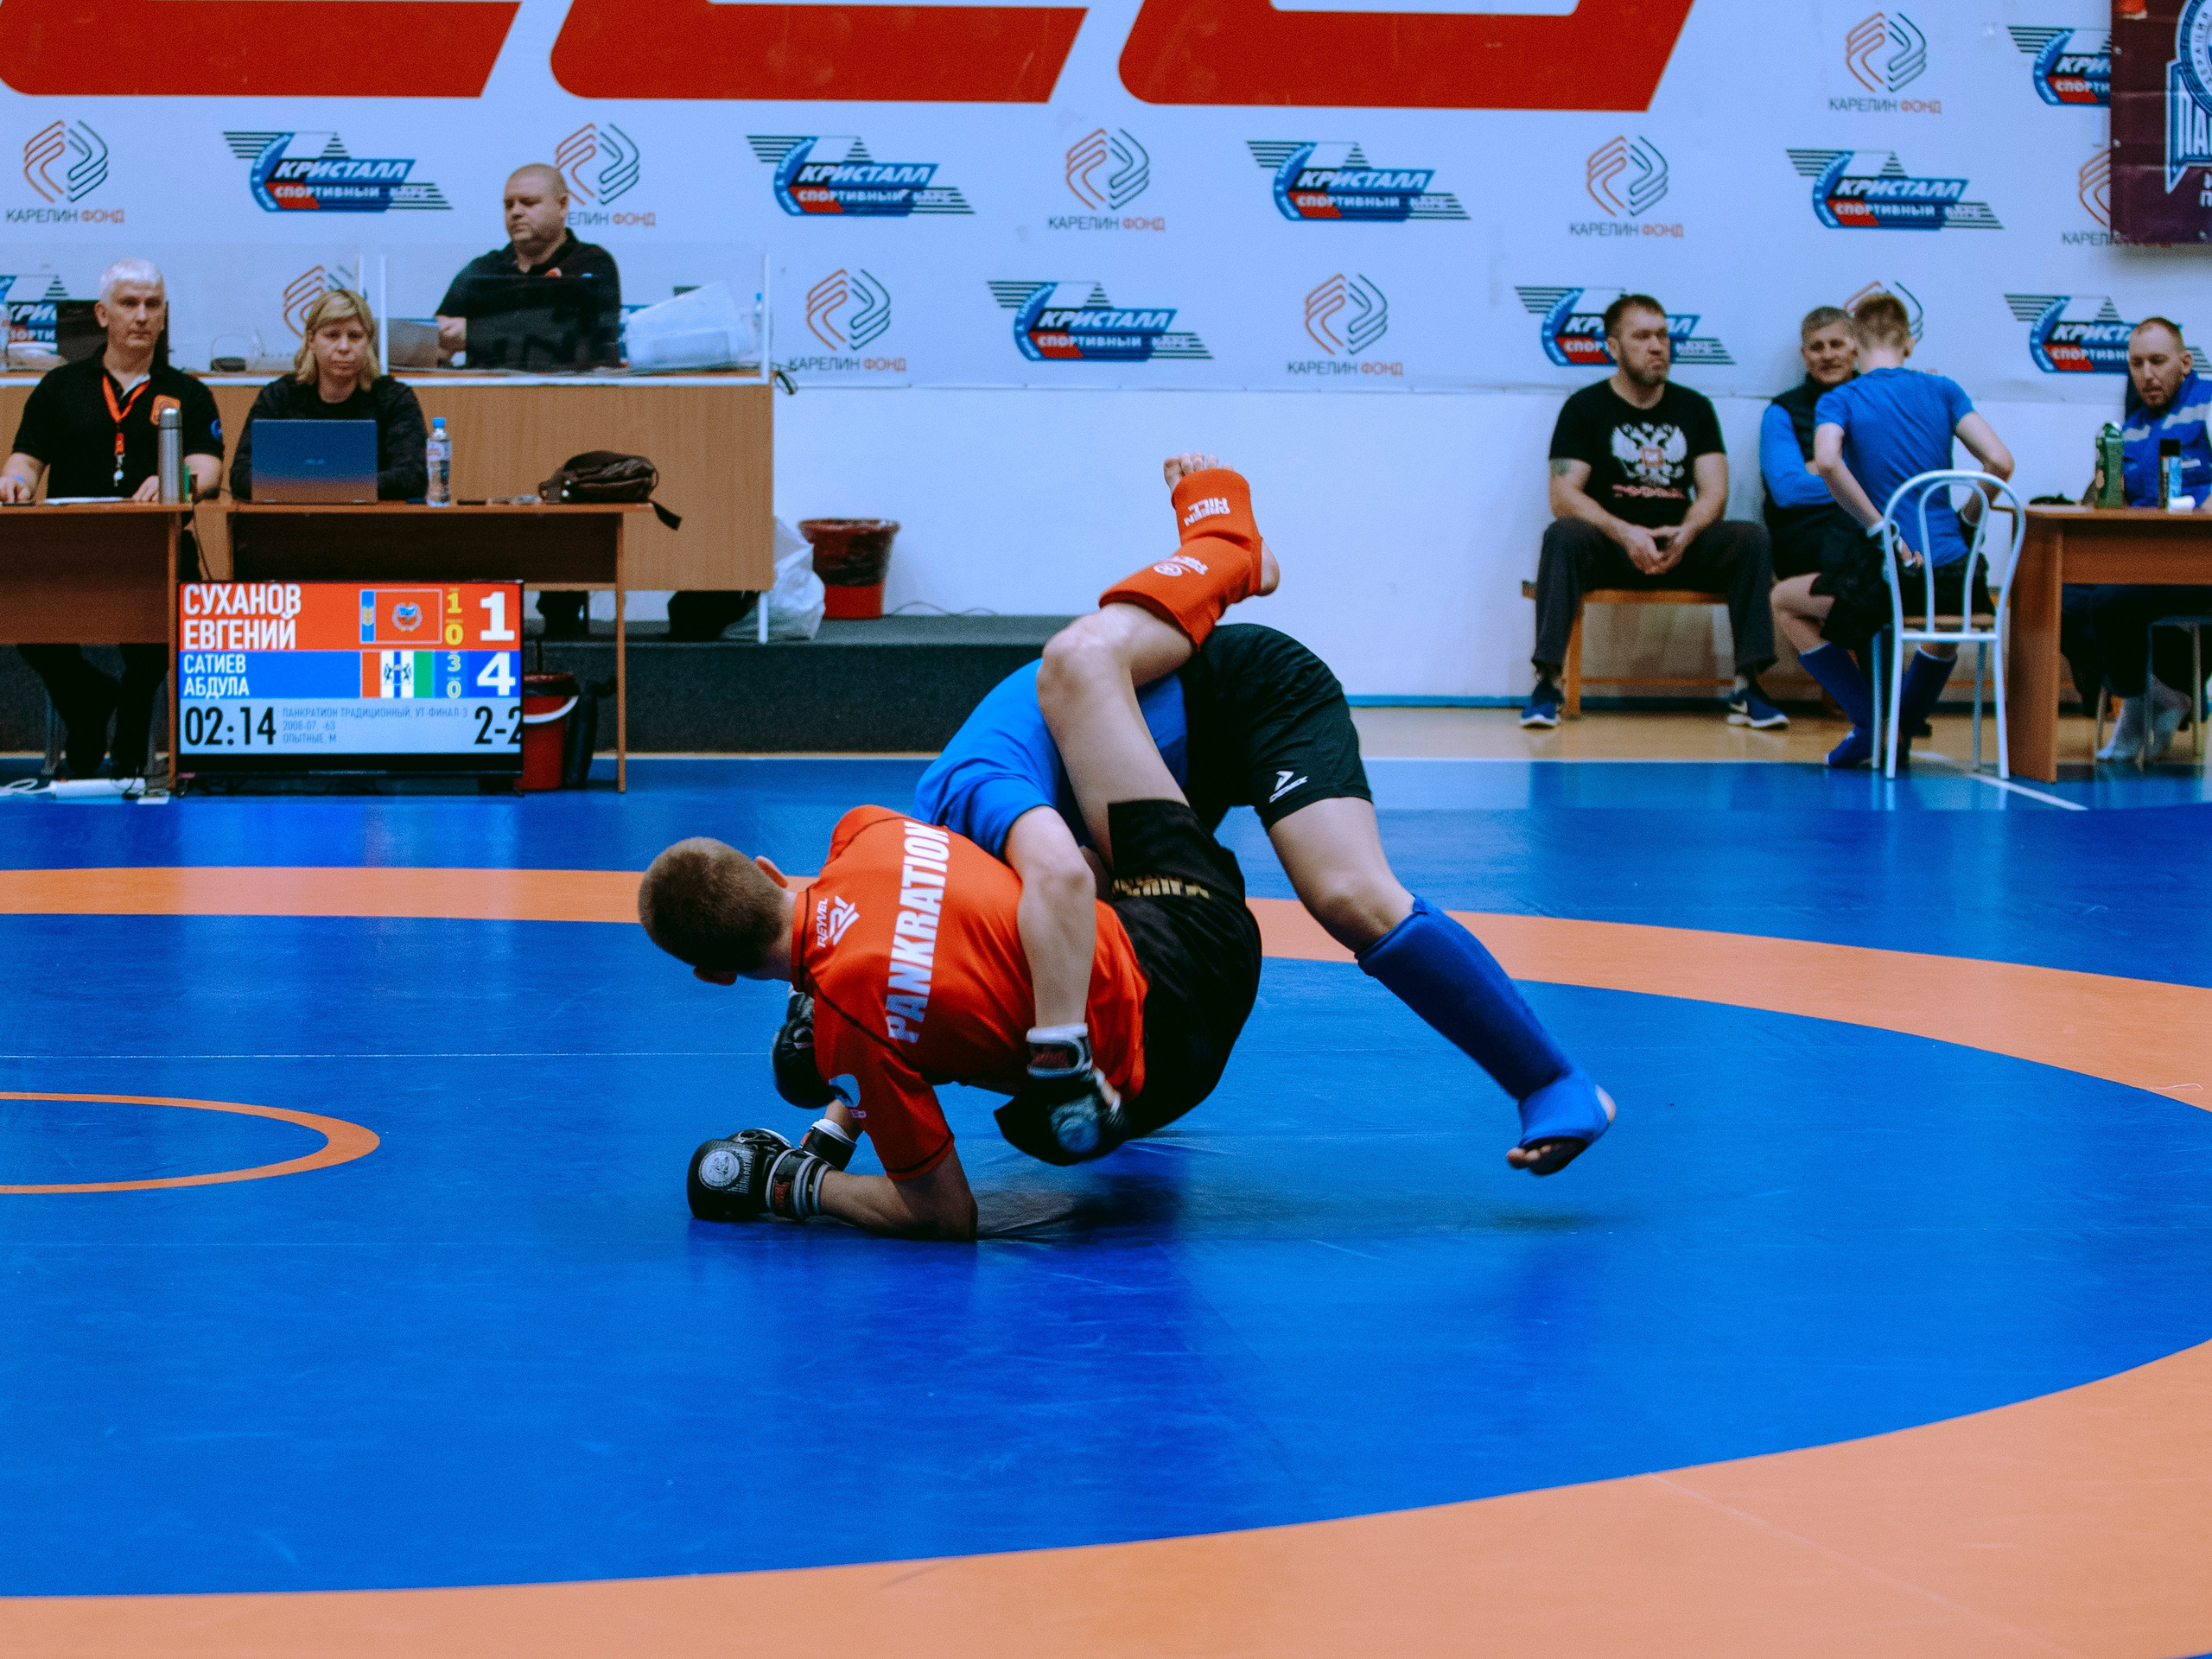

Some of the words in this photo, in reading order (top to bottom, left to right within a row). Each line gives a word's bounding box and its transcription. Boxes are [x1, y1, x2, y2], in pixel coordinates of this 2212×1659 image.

[1828, 98, 1897, 112] КАРЕЛИН
[1900, 99, 1942, 115] ФОНД
[274, 161, 409, 179] КРИСТАЛЛ
[798, 165, 930, 183] КРИСТАЛЛ
[1297, 171, 1427, 188] КРИСТАЛЛ
[1835, 179, 1961, 197] КРИСТАЛЛ
[273, 185, 380, 199] СПОРТИВНЫЙ
[798, 189, 904, 202] СПОРТИВНЫЙ
[1296, 195, 1400, 207] СПОРТИВНЫЙ
[1834, 203, 1936, 216] СПОРТИВНЫЙ
[6, 208, 78, 224] КАРЕЛИН
[81, 208, 125, 224] ФОНД
[567, 211, 609, 226] ЕЛИН
[612, 212, 656, 226] ФОНД
[1047, 215, 1120, 230] КАРЕЛИН
[1122, 216, 1166, 231] ФОНД
[1570, 222, 1639, 237] КАРЕЛИН
[1642, 223, 1684, 238] ФОНД
[1039, 311, 1170, 328] КРИСТАЛЛ
[1037, 335, 1142, 347] СПОРТИВНЫЙ
[787, 357, 860, 372] КАРЕЛИН
[863, 357, 906, 372] ФОНД
[1287, 361, 1357, 375] КАРЕЛИН
[1361, 361, 1403, 377] ФОНД
[184, 583, 302, 615] СУХАНОВ
[447, 593, 462, 614] 1
[480, 591, 515, 641] 1
[184, 612, 296, 650] ЕВГЕНИЙ
[445, 623, 464, 645] 0
[184, 654, 246, 674] САТИЕВ
[447, 655, 461, 672] 3
[477, 652, 516, 696] 4
[183, 677, 250, 700] АБДУЛА
[447, 681, 461, 698] 0
[283, 707, 338, 718] ПАНКРАТИОН
[185, 706, 276, 746] 02:14
[474, 705, 521, 745] 2-2
[885, 820, 950, 1044] PANKRATION
